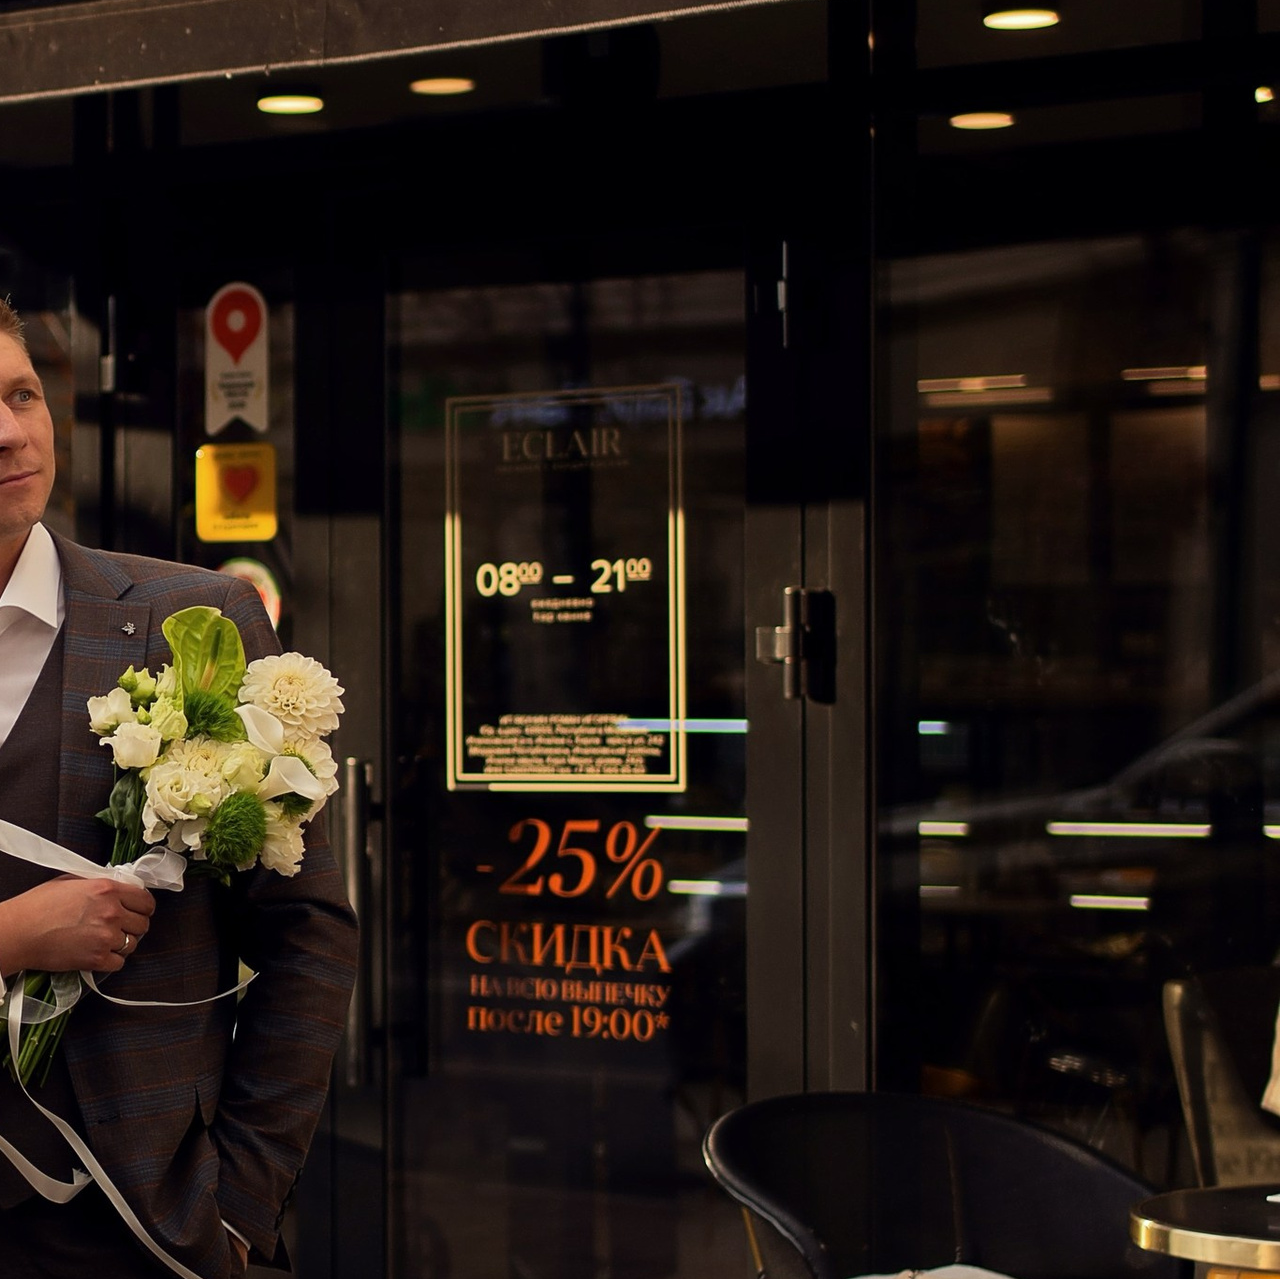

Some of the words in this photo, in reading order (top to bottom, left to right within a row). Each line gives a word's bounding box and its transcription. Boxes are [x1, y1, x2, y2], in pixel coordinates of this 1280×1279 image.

[501, 426, 622, 462] ECLAIR
[466, 920, 672, 976] СКИДКА
[470, 974, 502, 998] НА
[561, 979, 670, 1007] ВЫПЕЧКУ
[468, 1005, 564, 1036] после
